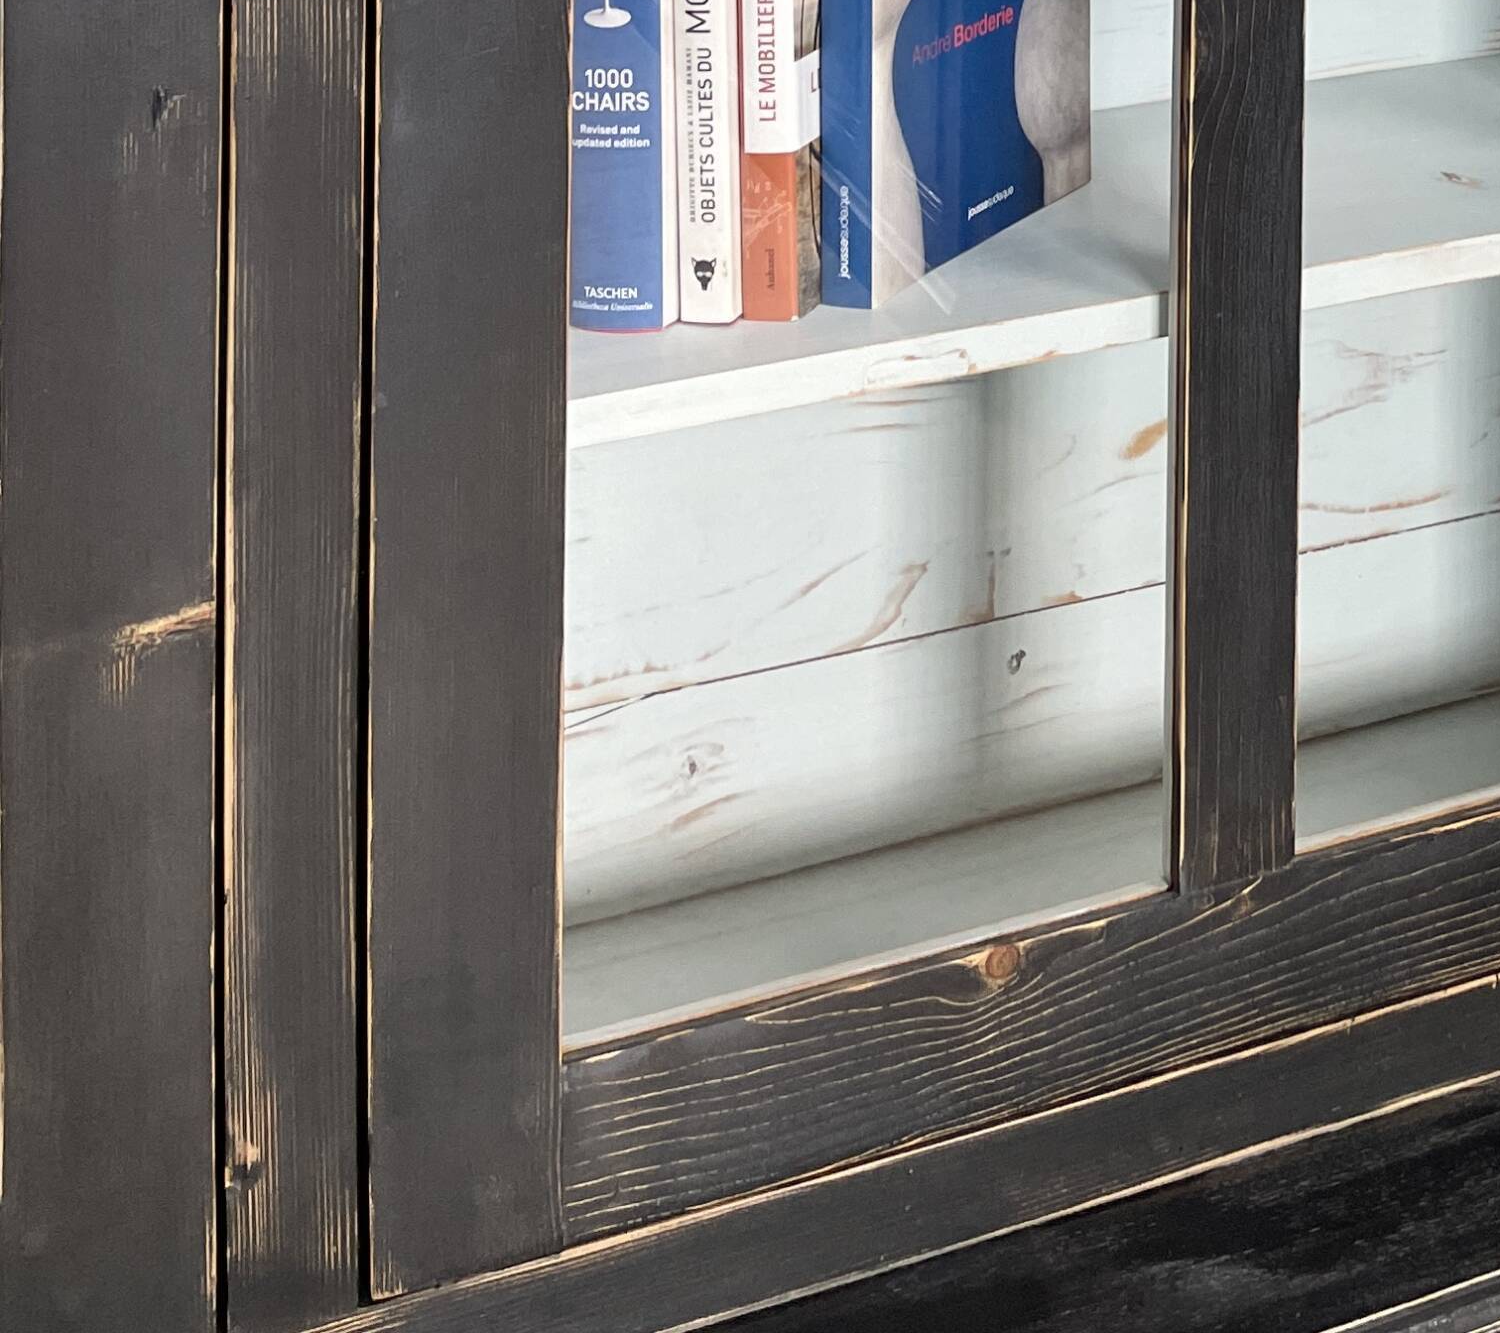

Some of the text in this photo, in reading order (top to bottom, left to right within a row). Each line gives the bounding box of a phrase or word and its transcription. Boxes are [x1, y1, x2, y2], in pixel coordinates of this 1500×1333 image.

[953, 4, 1014, 48] Borderie
[697, 46, 713, 72] DU
[572, 68, 650, 112] 1000 CHAIRS
[697, 78, 714, 148] CULTES
[759, 99, 777, 122] LE
[579, 124, 641, 135] Revised and
[571, 137, 651, 149] updated edition
[699, 153, 716, 223] OBJETS
[583, 285, 638, 300] TASCHEN
